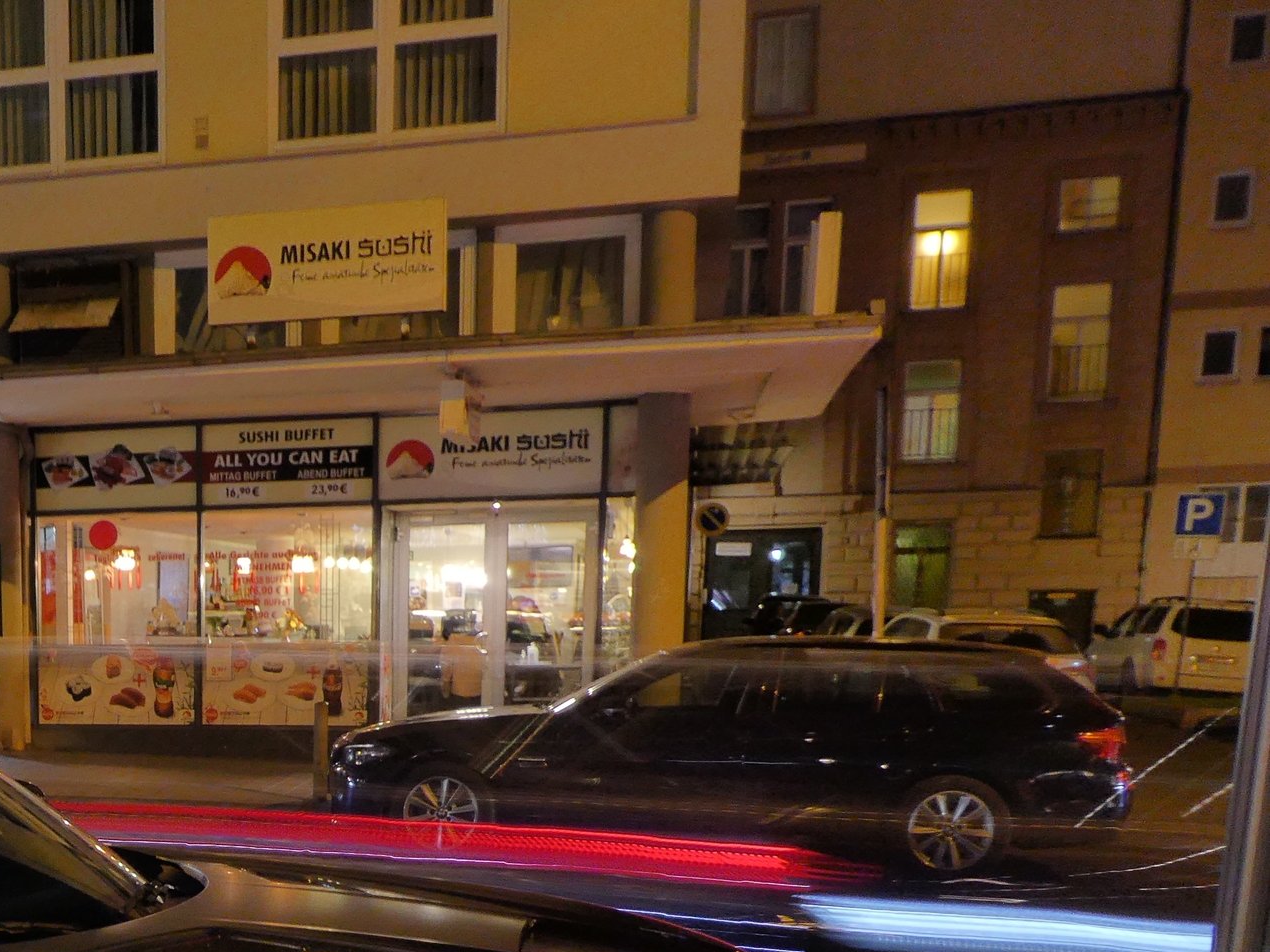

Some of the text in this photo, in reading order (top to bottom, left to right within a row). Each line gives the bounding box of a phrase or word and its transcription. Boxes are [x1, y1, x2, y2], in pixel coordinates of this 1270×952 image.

[280, 229, 433, 265] MISAKI sushi
[238, 428, 335, 444] SUSHI BUFFET
[516, 428, 590, 451] sushi
[214, 449, 359, 468] ALL YOU CAN EAT
[209, 470, 277, 482] MITTAG BUFFET
[297, 466, 365, 480] ABEND BUFFET
[1184, 498, 1215, 531] P
